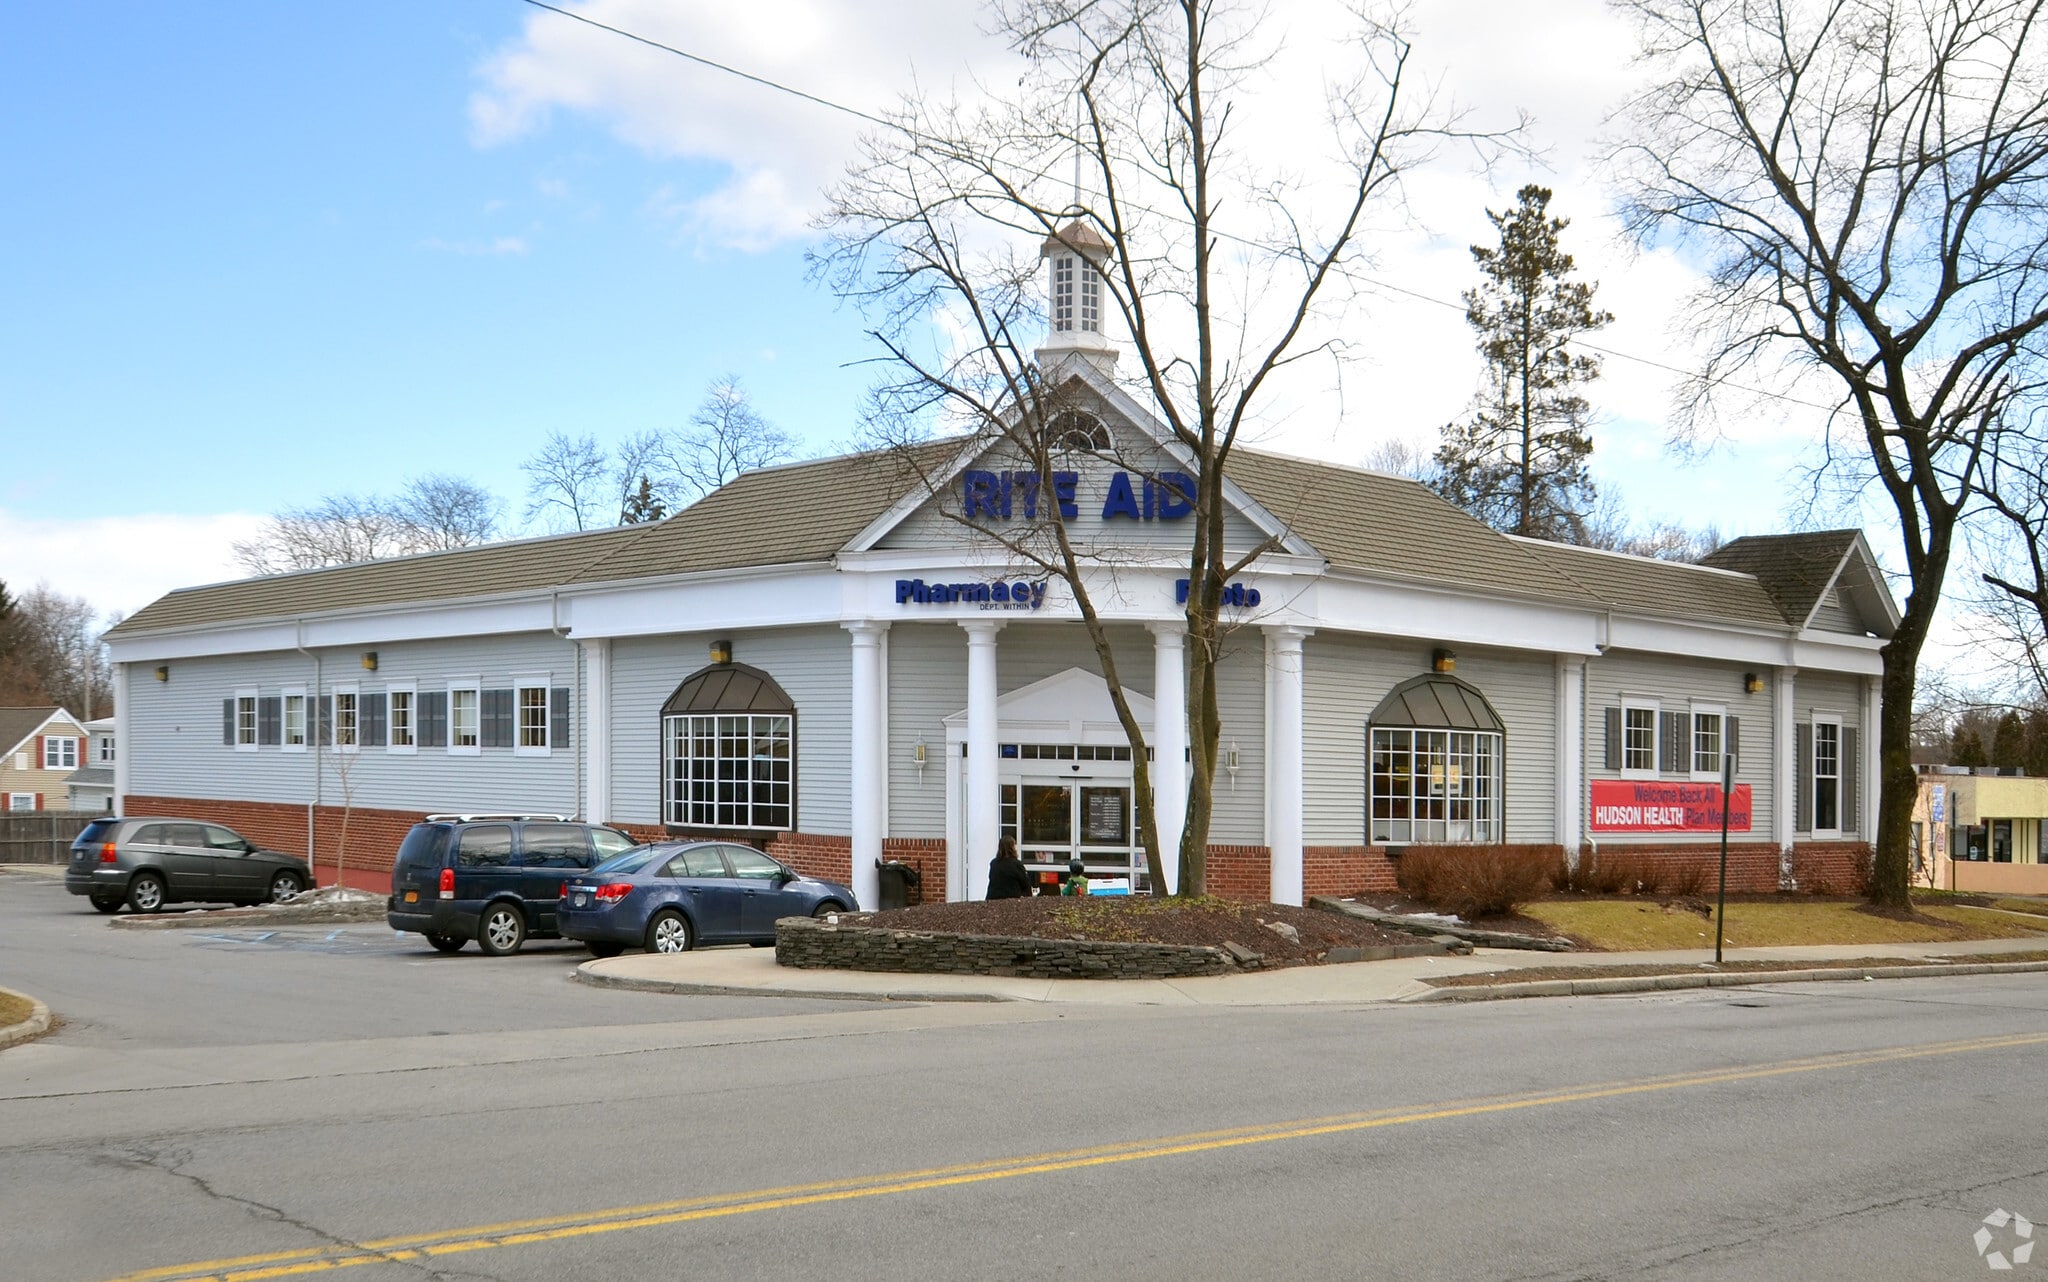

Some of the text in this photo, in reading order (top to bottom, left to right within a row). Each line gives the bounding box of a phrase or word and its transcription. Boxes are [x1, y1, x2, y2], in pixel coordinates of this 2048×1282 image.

[964, 470, 1198, 519] RITE AID
[896, 578, 1047, 609] Pharmacy
[1176, 578, 1261, 607] Poto
[979, 603, 1030, 611] DEPT. WITHIN
[1634, 784, 1716, 803] Welcome Back All
[1595, 805, 1748, 825] HUDSON HEALTH Plan Mebers
